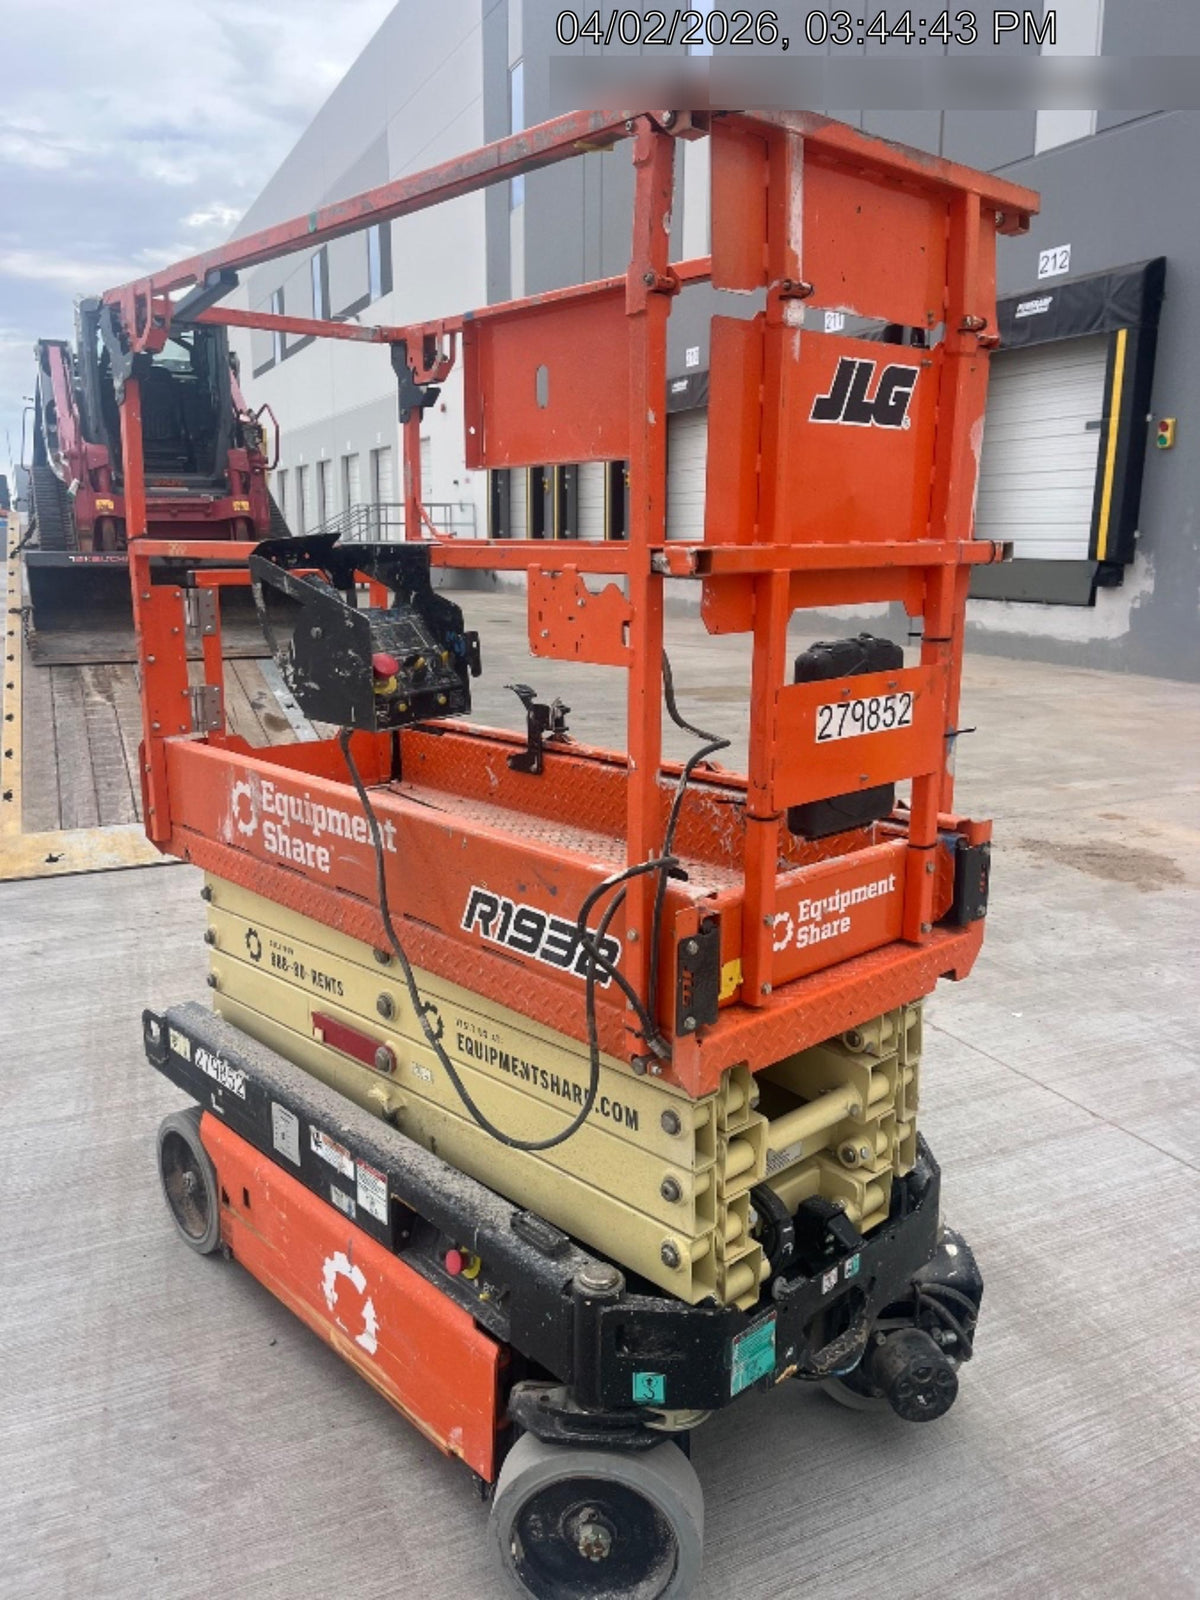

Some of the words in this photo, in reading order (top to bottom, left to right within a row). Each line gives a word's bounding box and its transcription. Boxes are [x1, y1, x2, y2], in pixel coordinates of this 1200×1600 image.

[1039, 248, 1070, 275] 212
[809, 356, 920, 430] JLG
[817, 692, 912, 741] 279852
[260, 780, 398, 853] Equipment
[262, 820, 331, 873] Share
[798, 873, 896, 923] Equipment
[460, 885, 622, 990] R1932
[796, 916, 851, 949] Share
